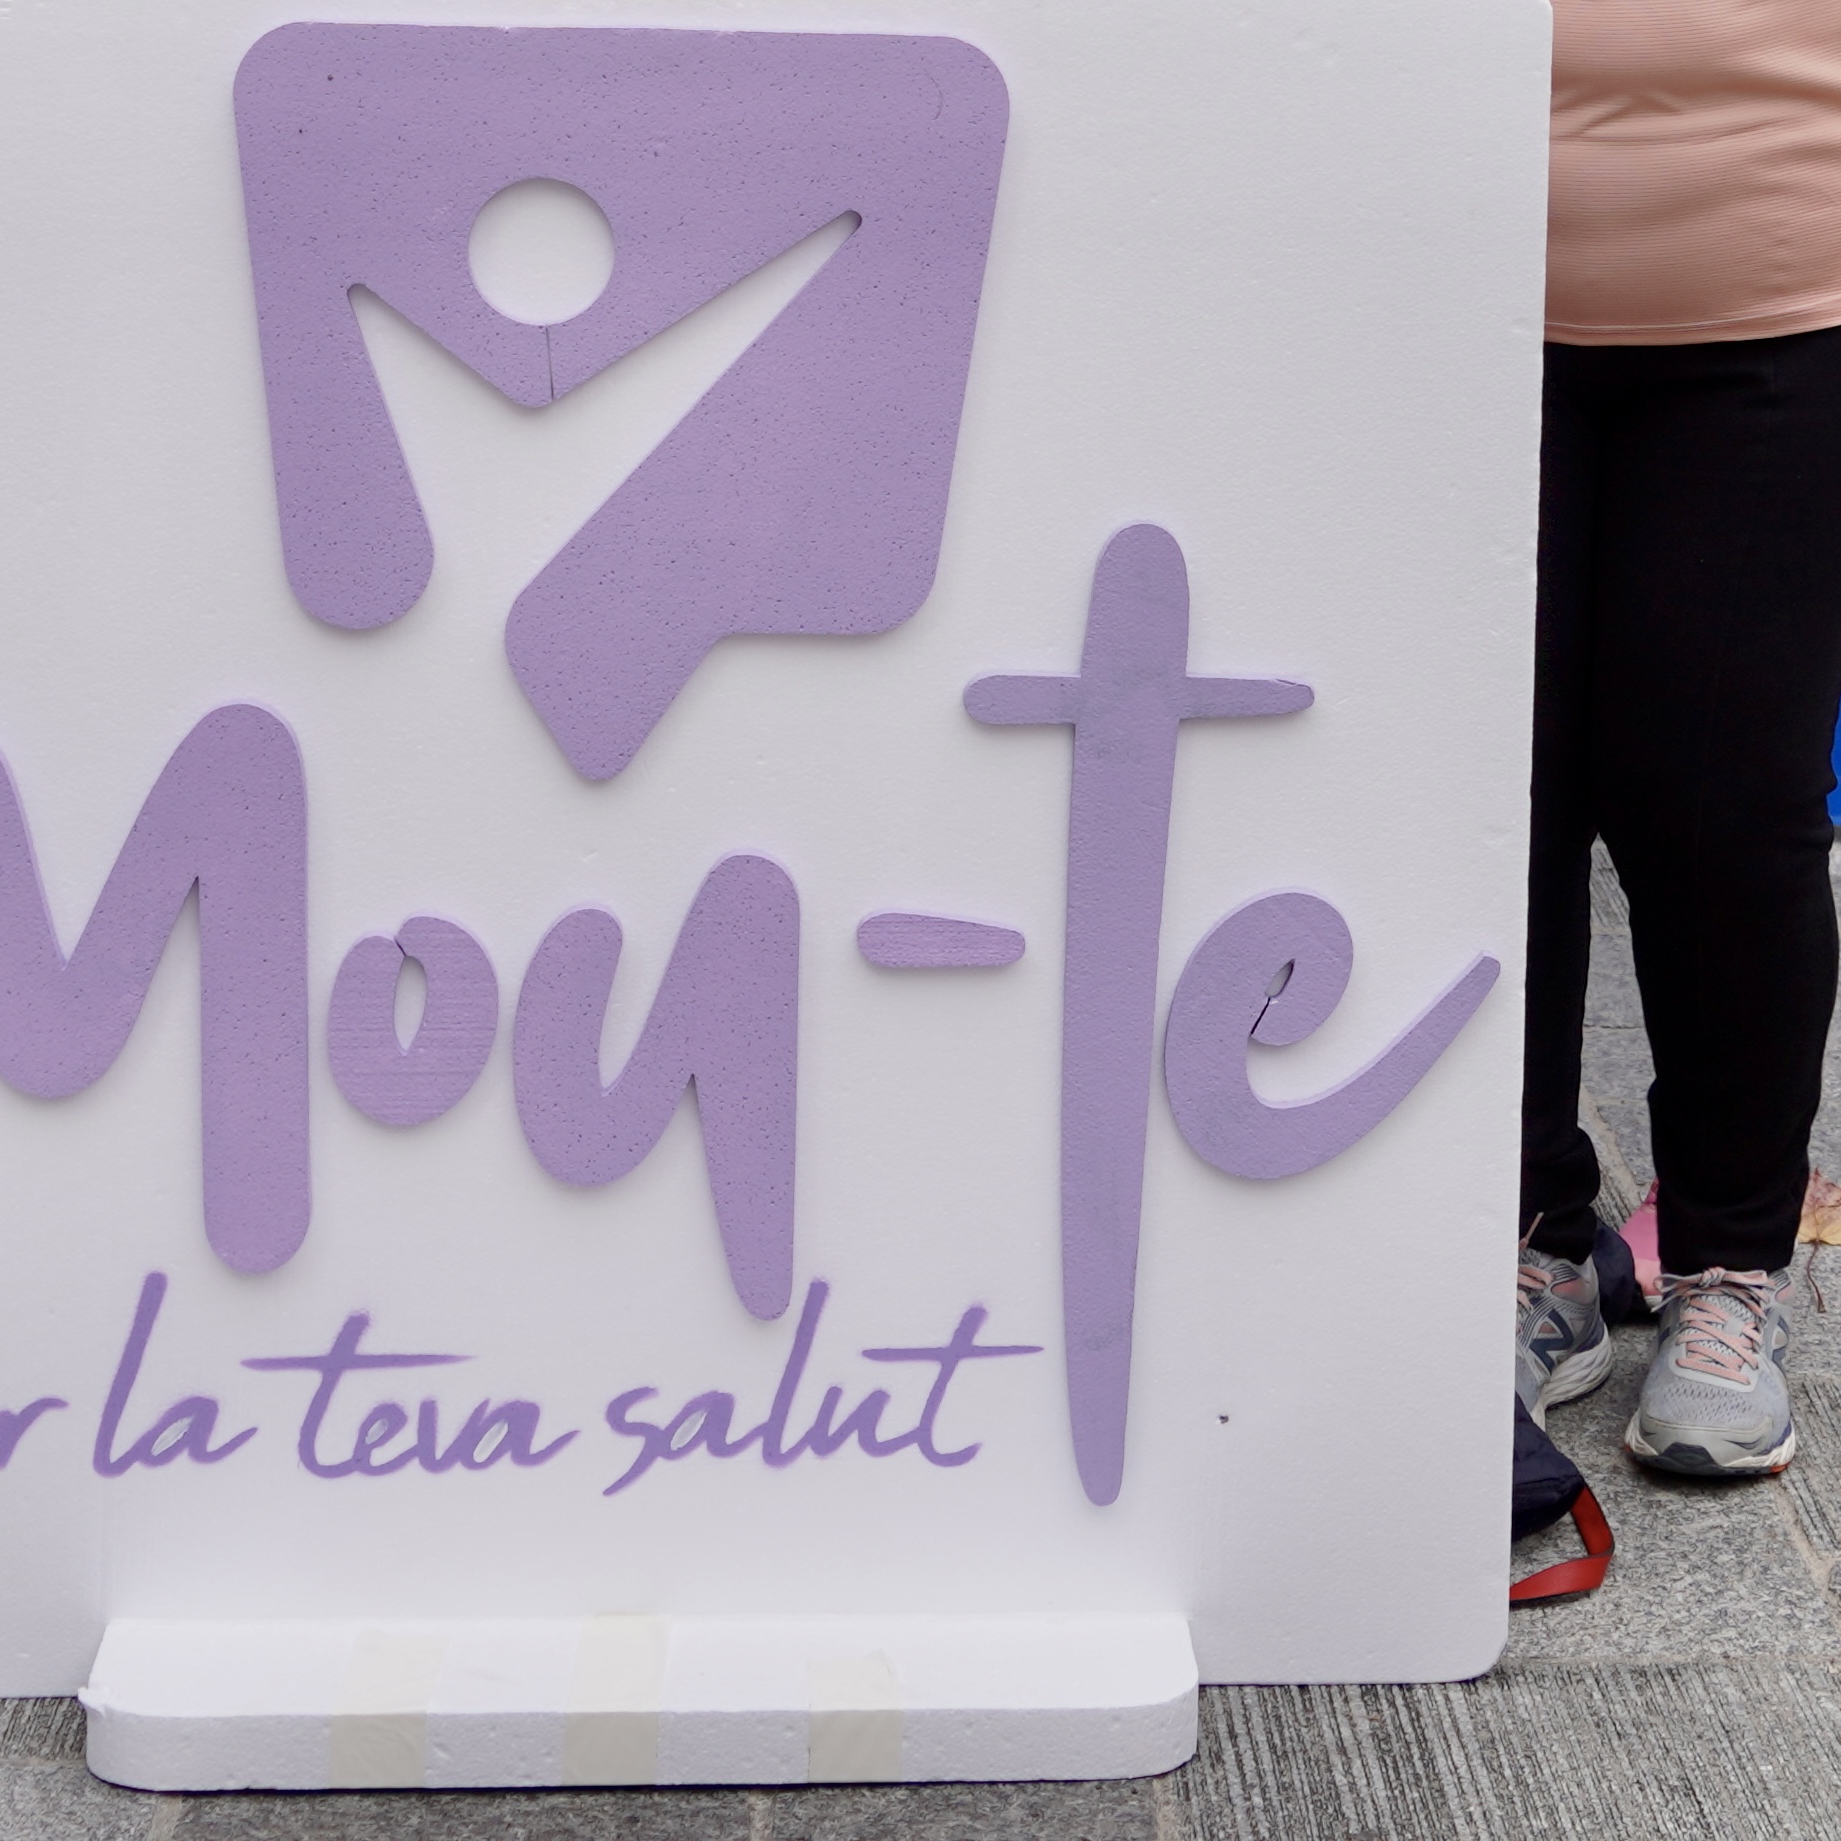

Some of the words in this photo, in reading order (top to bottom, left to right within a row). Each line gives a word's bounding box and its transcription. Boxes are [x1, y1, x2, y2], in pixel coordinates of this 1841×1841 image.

[90, 1270, 262, 1480] la
[238, 1308, 582, 1481] teva
[598, 1280, 1046, 1498] salut
